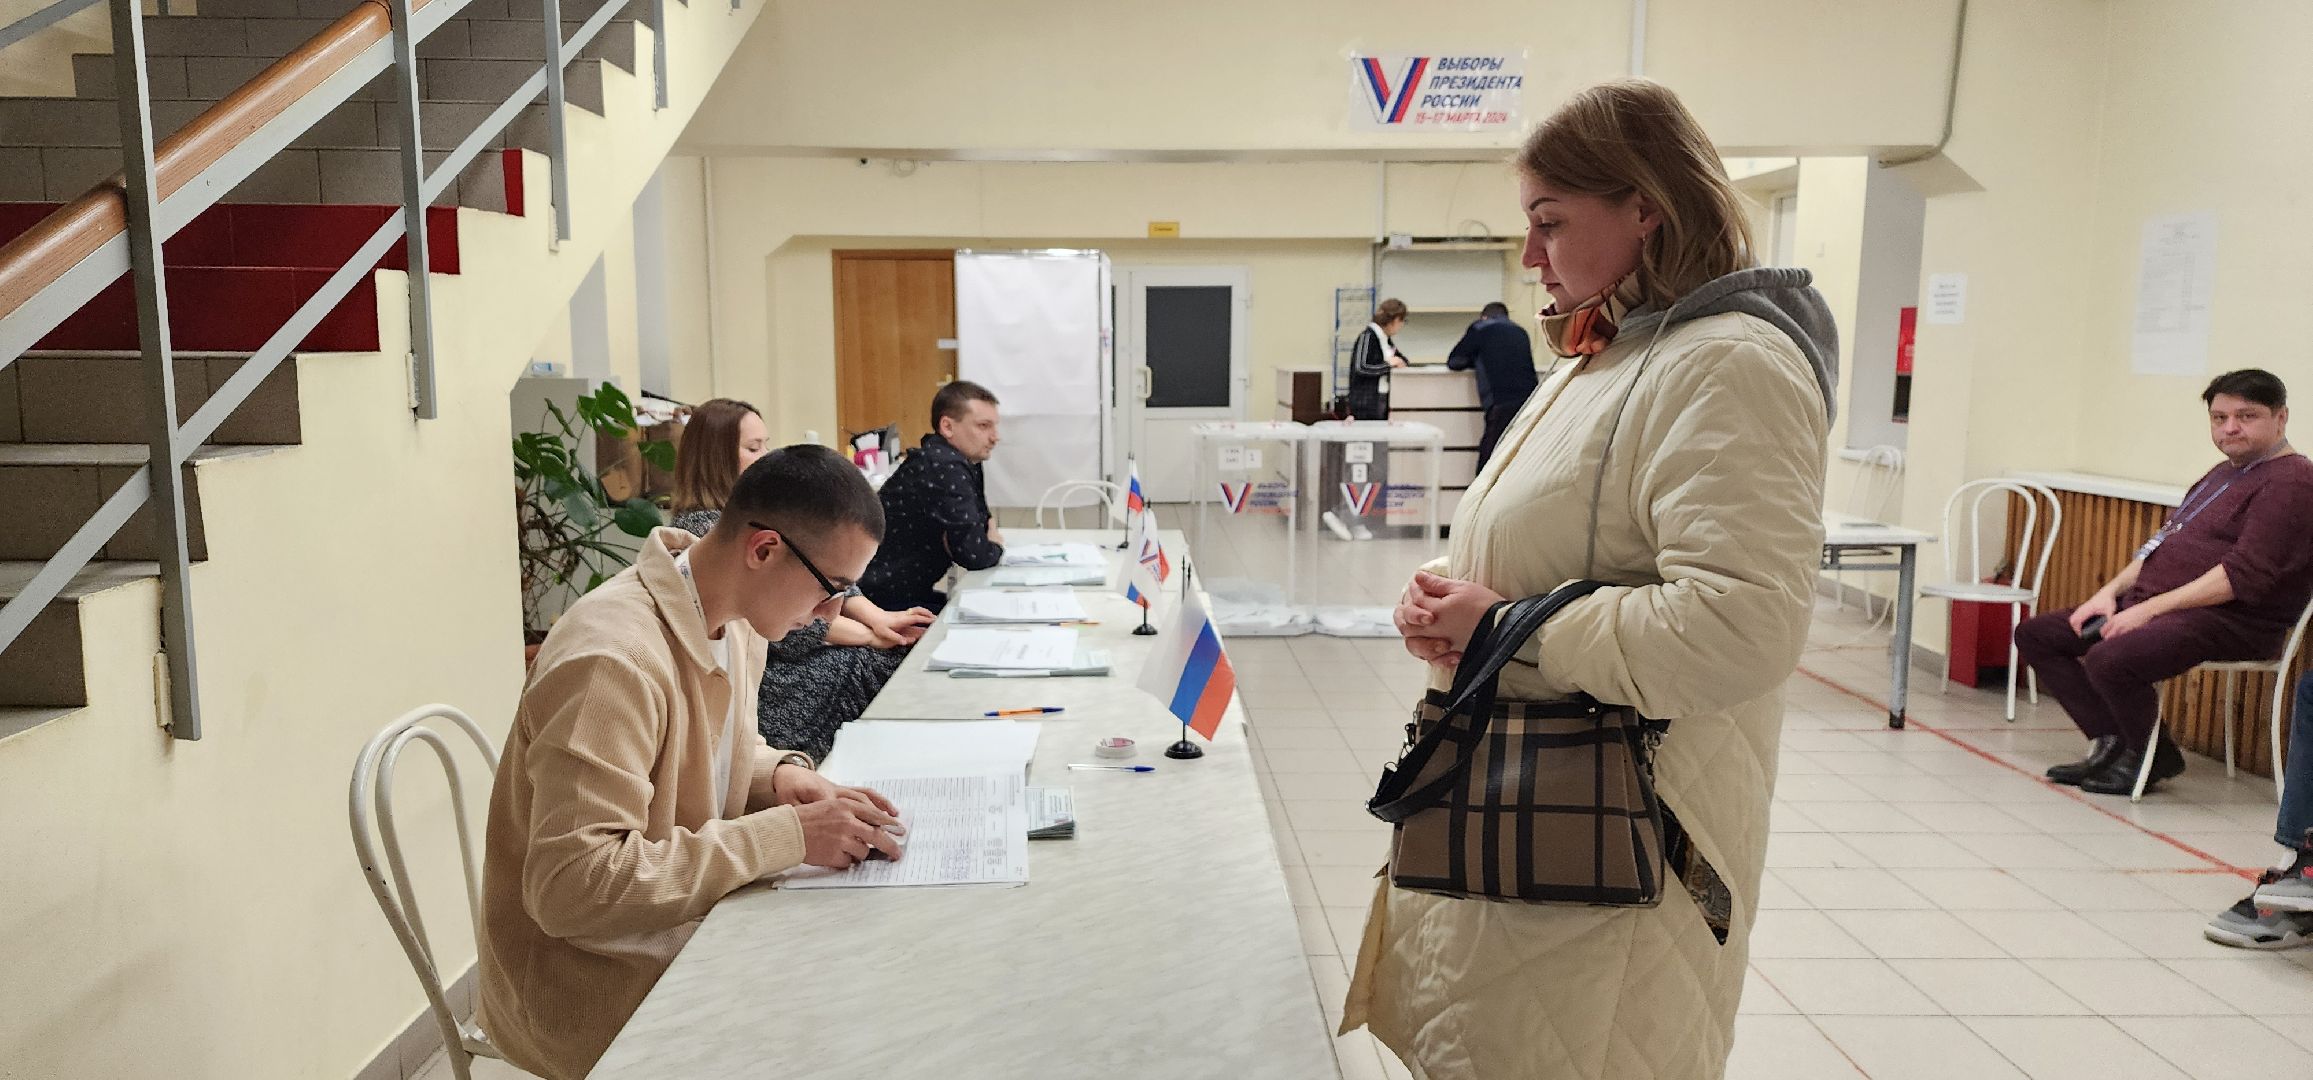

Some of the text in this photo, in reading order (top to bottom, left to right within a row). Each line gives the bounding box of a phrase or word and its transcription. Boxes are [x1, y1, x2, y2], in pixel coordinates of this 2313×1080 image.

[1437, 57, 1504, 71] ВЫБОРЫ
[1429, 76, 1522, 90] ПРЕЗИДЕНТА
[1420, 94, 1482, 108] РОССИИ
